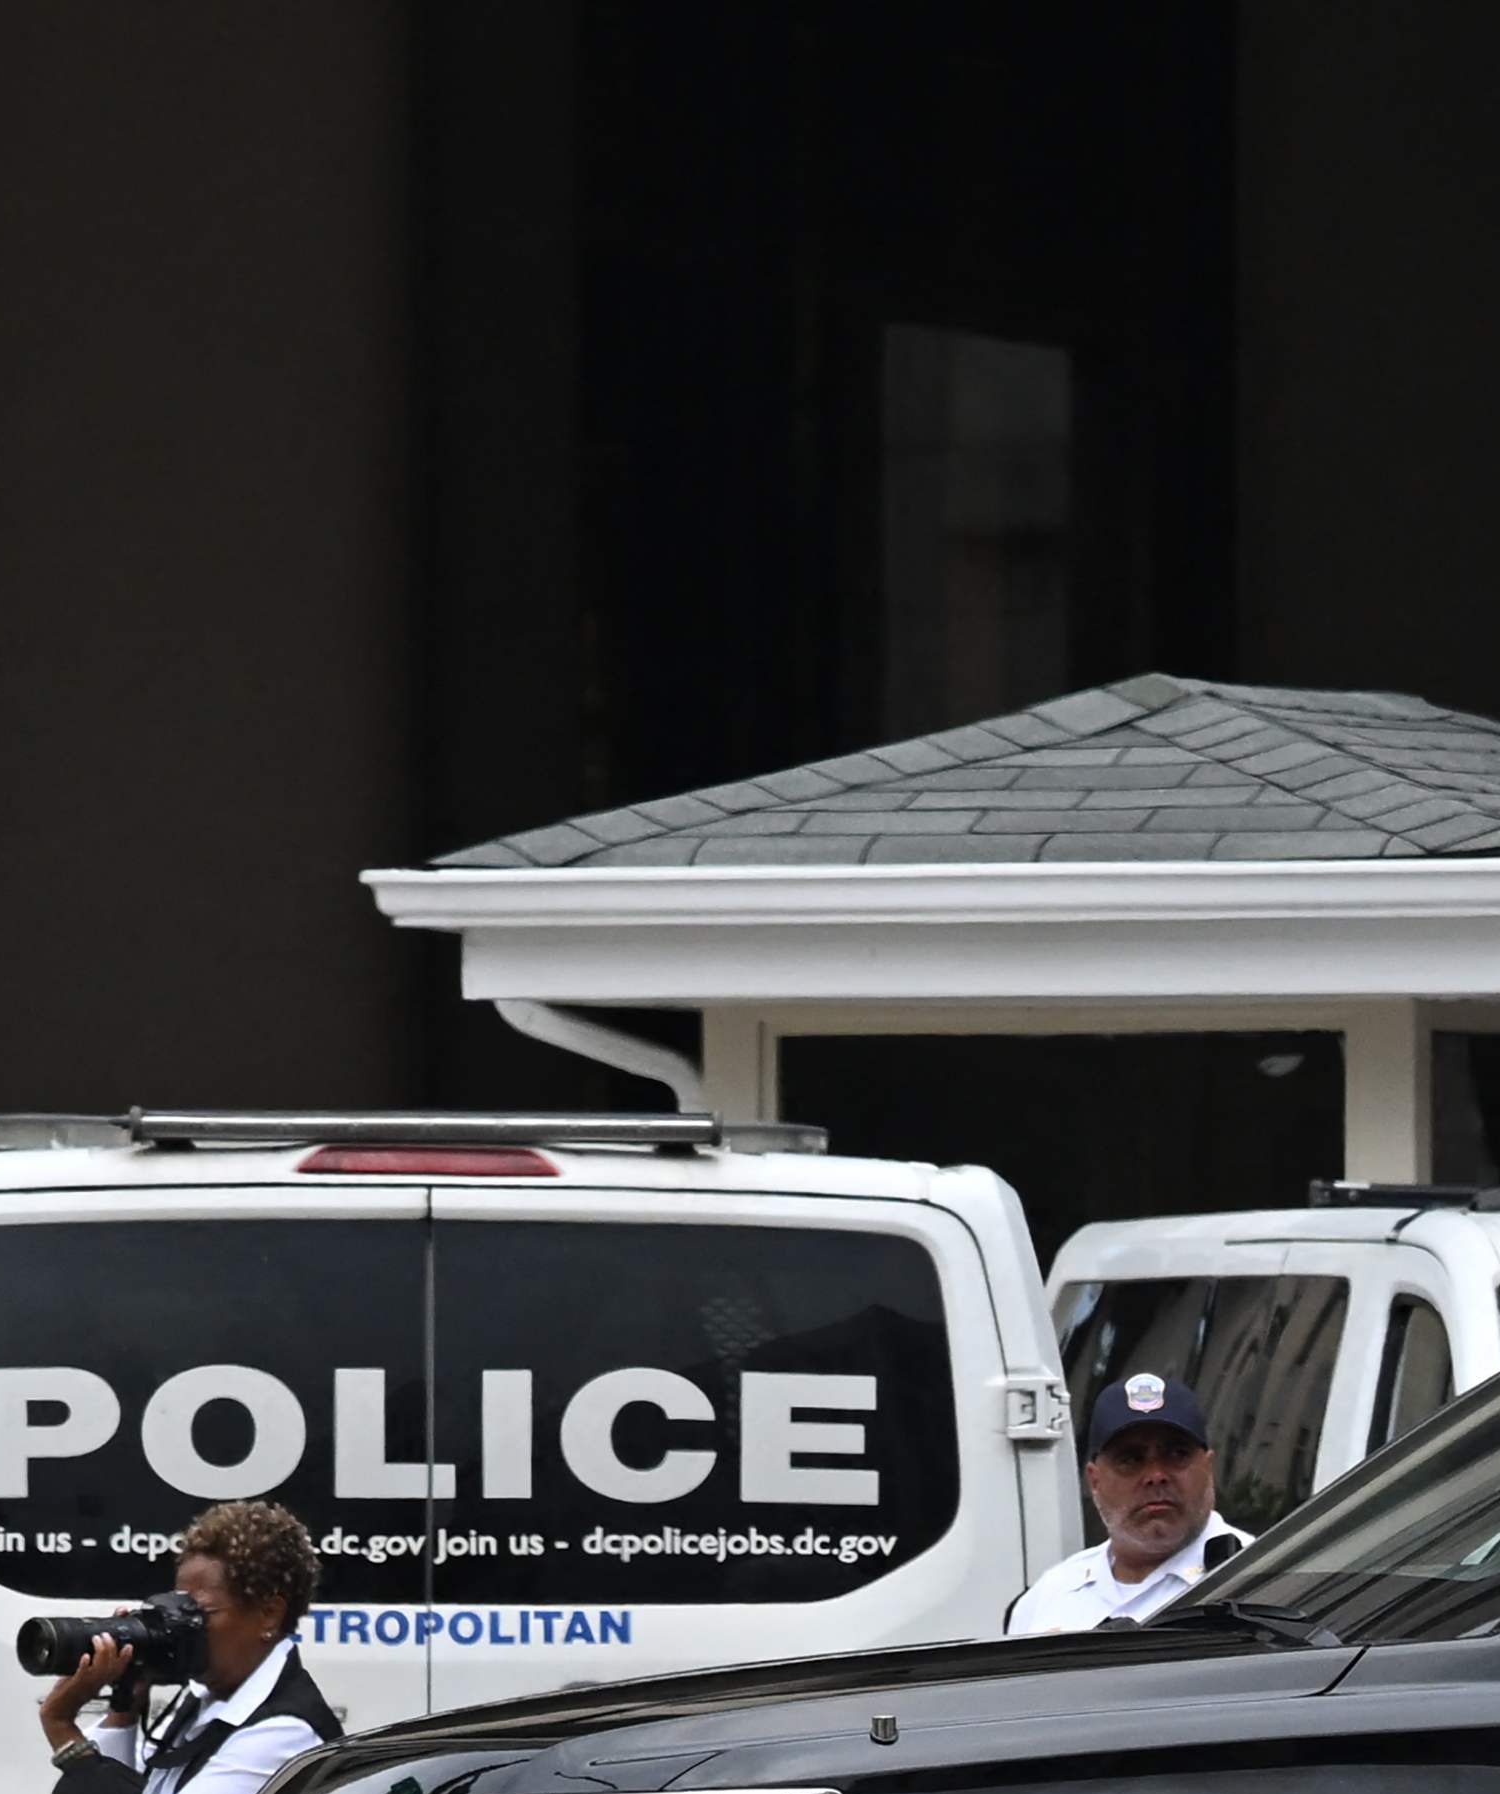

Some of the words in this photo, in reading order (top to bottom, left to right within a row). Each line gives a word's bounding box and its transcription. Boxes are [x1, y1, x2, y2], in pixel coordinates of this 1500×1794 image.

[36, 1530, 72, 1554] us
[433, 1528, 498, 1565] Join
[509, 1532, 544, 1556] us
[582, 1526, 898, 1563] dcpolicejobs.dc.gov
[291, 1609, 632, 1645] TROPOLITAN
